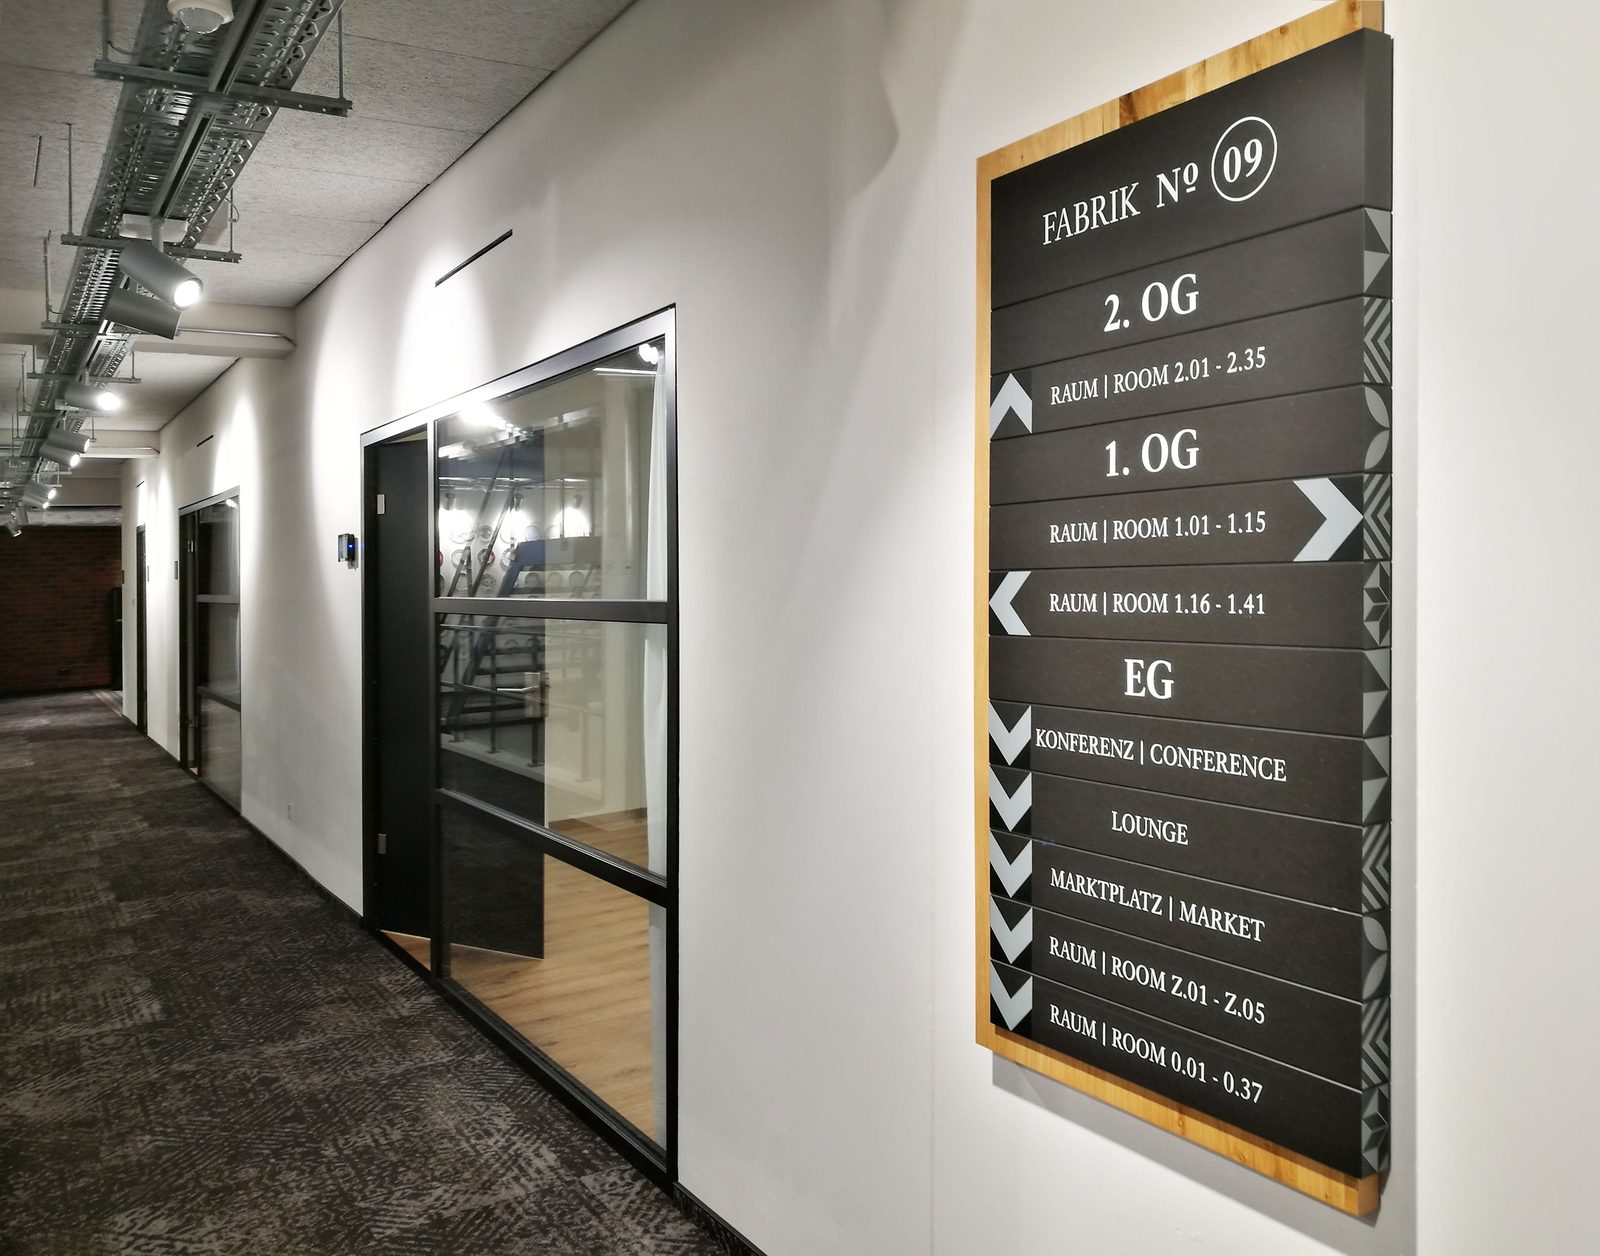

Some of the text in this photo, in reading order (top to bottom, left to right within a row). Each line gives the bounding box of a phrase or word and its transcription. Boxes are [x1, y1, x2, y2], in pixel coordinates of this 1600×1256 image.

[1042, 181, 1141, 247] FABRIK
[1222, 138, 1263, 184] 09
[1103, 273, 1200, 333] 2. OG
[1050, 377, 1099, 406] RAUM
[1112, 363, 1170, 394] ROOM
[1173, 356, 1210, 384] 2.01
[1226, 345, 1267, 375] 2.35
[1104, 428, 1200, 478] 1. OG
[1049, 521, 1099, 544] RAUM
[1112, 516, 1170, 541] ROOM
[1174, 514, 1211, 537] 1.01
[1227, 510, 1266, 535] 1.15
[1049, 592, 1099, 613] RAUM
[1112, 592, 1169, 614] ROOM
[1174, 592, 1211, 615] 1.16
[1227, 592, 1266, 615] 1.41
[1123, 658, 1175, 700] EG
[1035, 728, 1135, 761] KONFERENZ
[1149, 743, 1288, 783] CONFERENCE
[1111, 810, 1190, 846] LOUNGE
[1050, 867, 1163, 917] MARKTPLATZ
[1178, 900, 1266, 943] MARKET
[1049, 935, 1097, 970] RAUM
[1111, 955, 1167, 993] ROOM
[1170, 974, 1208, 1007] Z.01
[1223, 991, 1265, 1025] Z.05
[1049, 1003, 1097, 1040] RAUM
[1111, 1027, 1167, 1068] ROOM
[1171, 1051, 1207, 1084] 0.01
[1223, 1070, 1263, 1104] 0.37
